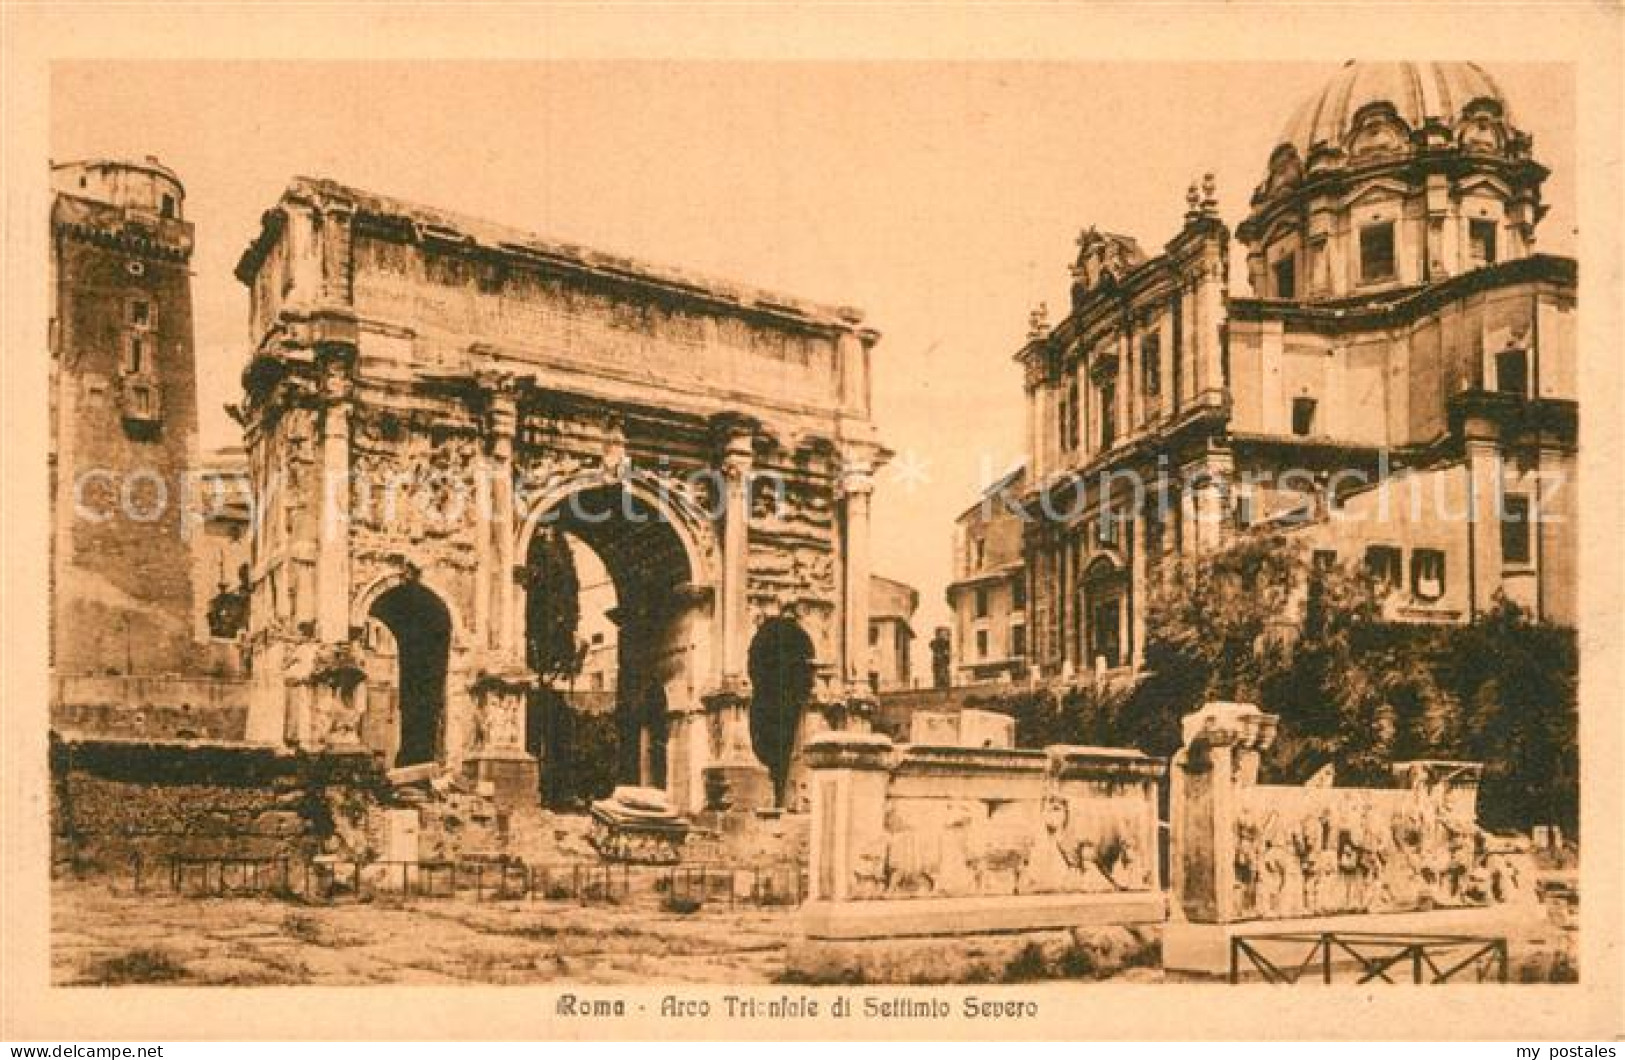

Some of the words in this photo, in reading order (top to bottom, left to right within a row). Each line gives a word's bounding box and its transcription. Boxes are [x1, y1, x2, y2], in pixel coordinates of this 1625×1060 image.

[556, 994, 625, 1017] Roma
[661, 995, 711, 1017] Arco
[831, 995, 850, 1018] di
[863, 996, 950, 1018] Settimio
[963, 997, 1039, 1019] Severo
